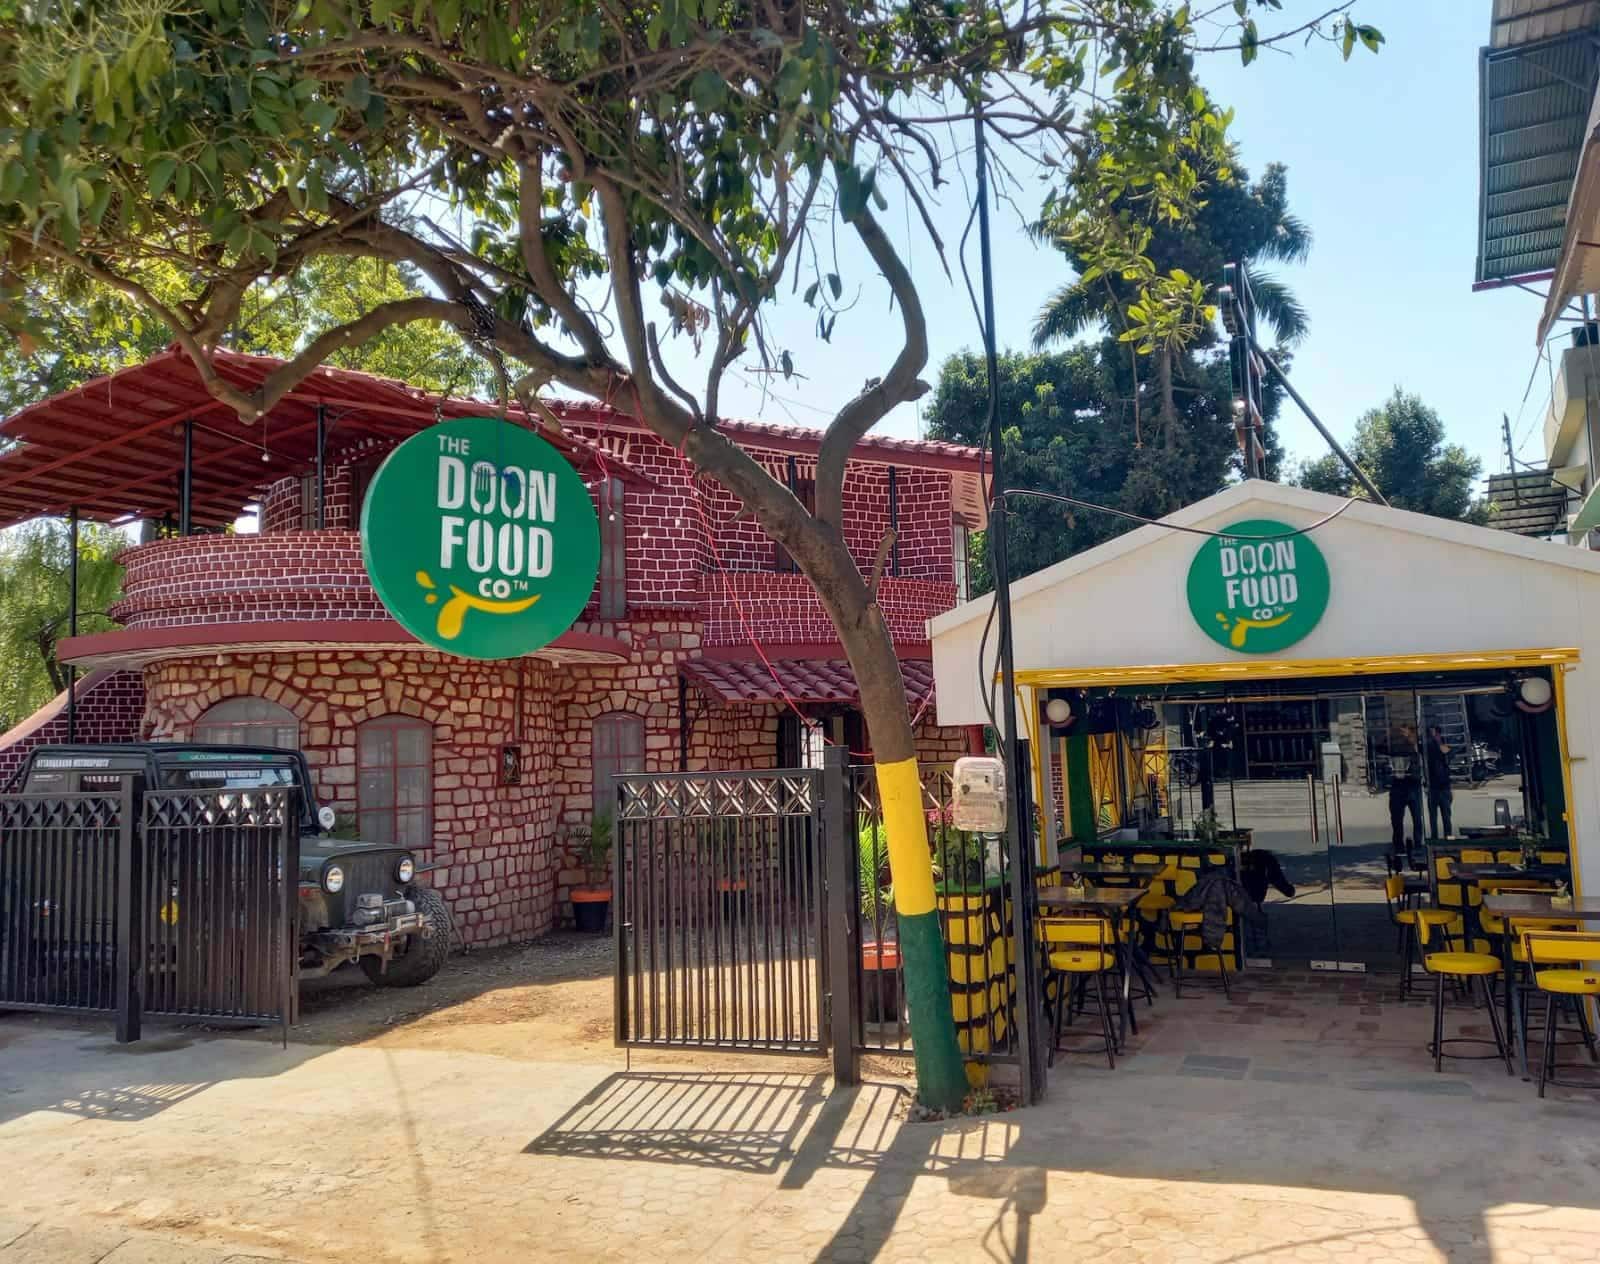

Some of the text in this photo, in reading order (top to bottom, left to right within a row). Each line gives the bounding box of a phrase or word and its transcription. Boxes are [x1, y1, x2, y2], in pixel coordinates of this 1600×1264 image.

[437, 434, 471, 456] THE
[437, 456, 556, 523] DOON
[440, 515, 553, 578] FOOD
[1220, 540, 1296, 577] DOON
[478, 578, 511, 599] CO
[1226, 573, 1298, 609] FOOD
[1252, 607, 1273, 620] CO
